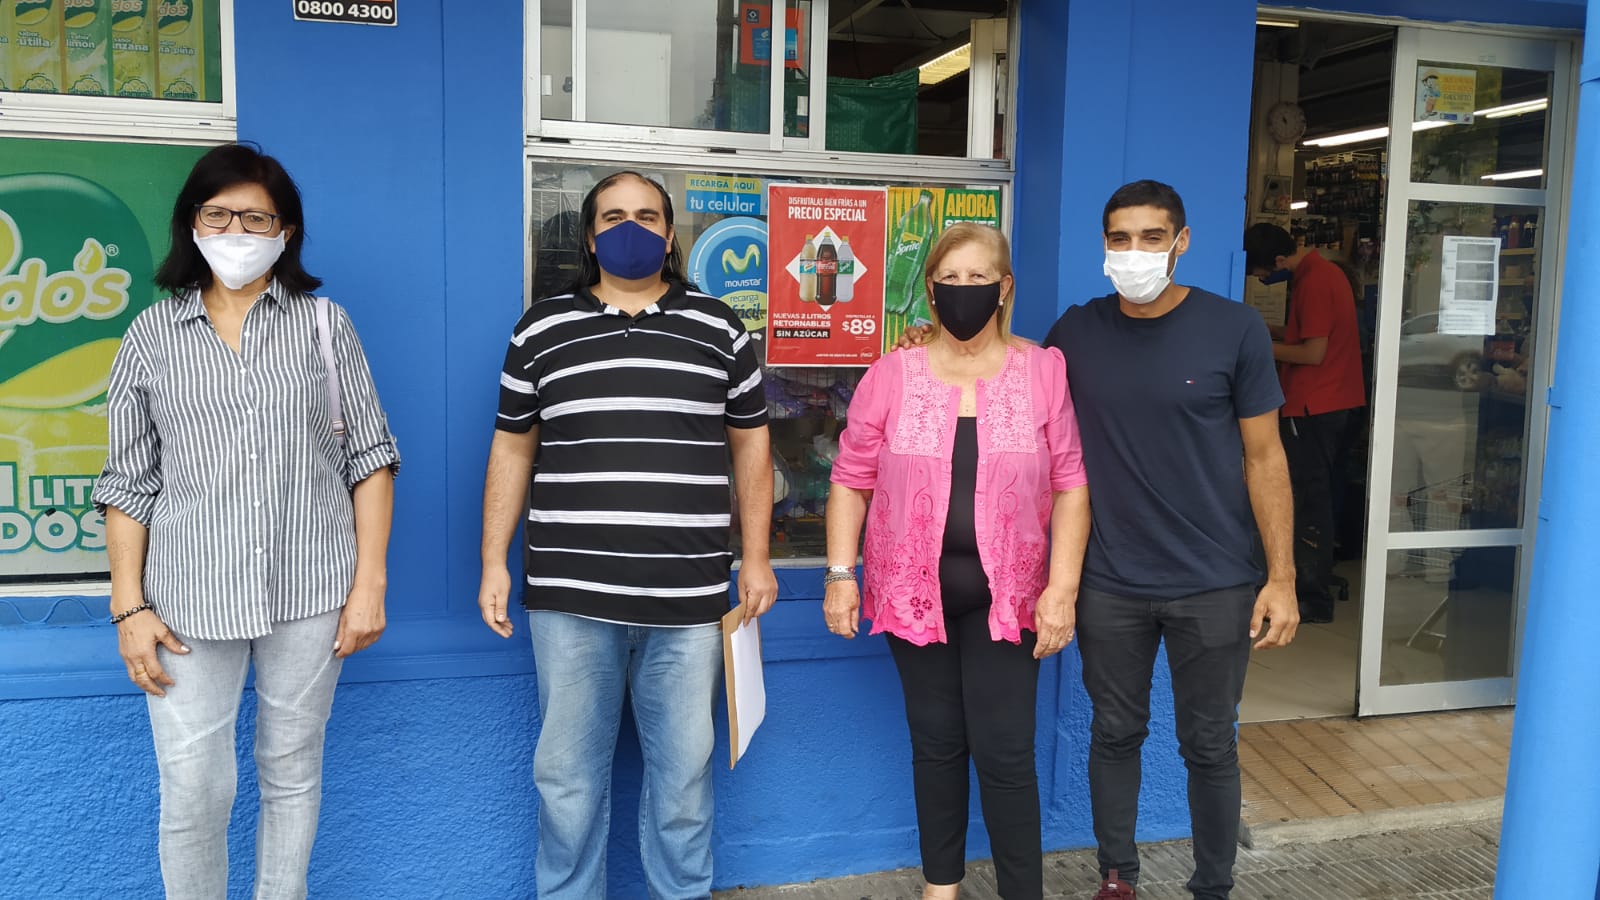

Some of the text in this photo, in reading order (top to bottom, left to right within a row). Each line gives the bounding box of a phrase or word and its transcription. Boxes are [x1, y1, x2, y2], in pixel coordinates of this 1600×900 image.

[298, 0, 393, 19] 0800 4300
[690, 179, 729, 188] RECARGA
[690, 195, 756, 213] tu celular
[853, 199, 859, 207] A
[945, 193, 997, 218] AHORA
[788, 206, 868, 222] PRECIO ESPECIAL
[724, 278, 762, 288] movistar
[729, 294, 759, 304] recarga
[793, 329, 829, 338] AZÚCAR
[842, 319, 876, 335] $89
[33, 478, 98, 507] LIT
